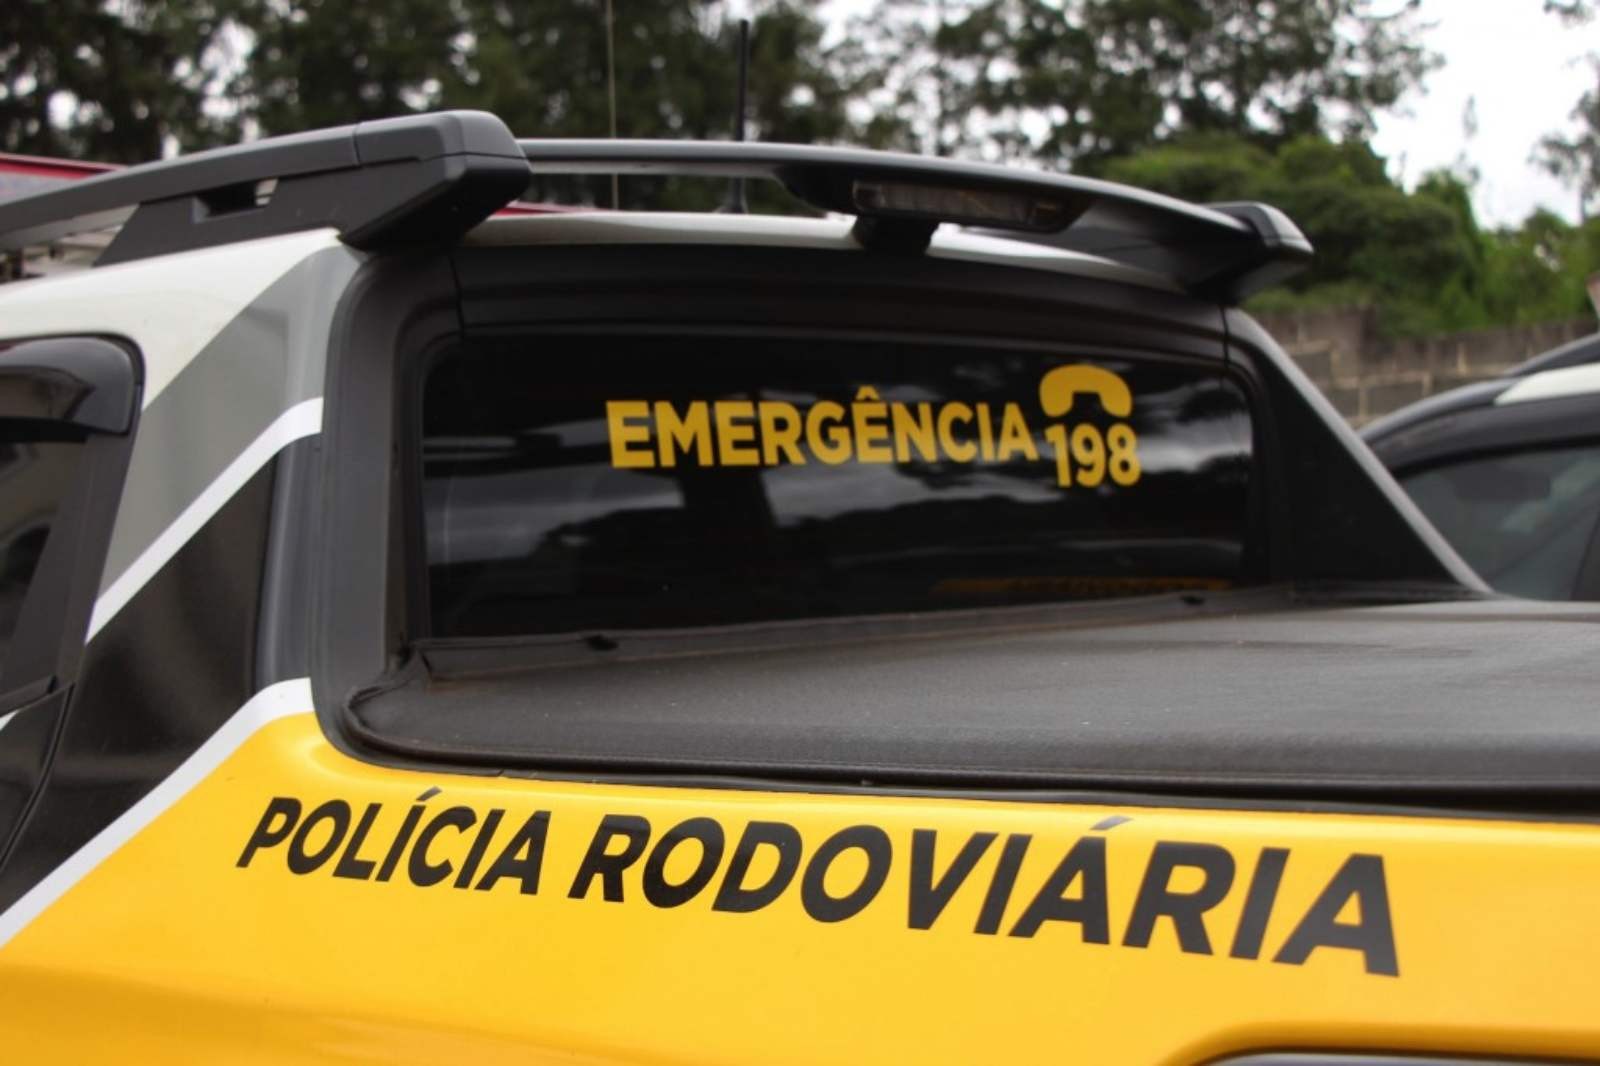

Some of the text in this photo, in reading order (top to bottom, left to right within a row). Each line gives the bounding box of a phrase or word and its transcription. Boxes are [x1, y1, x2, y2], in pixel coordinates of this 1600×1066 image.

[606, 386, 1142, 488] EMERGÊNCIA 198
[236, 787, 1401, 978] POLÍCIA RODOVIÁRIA
